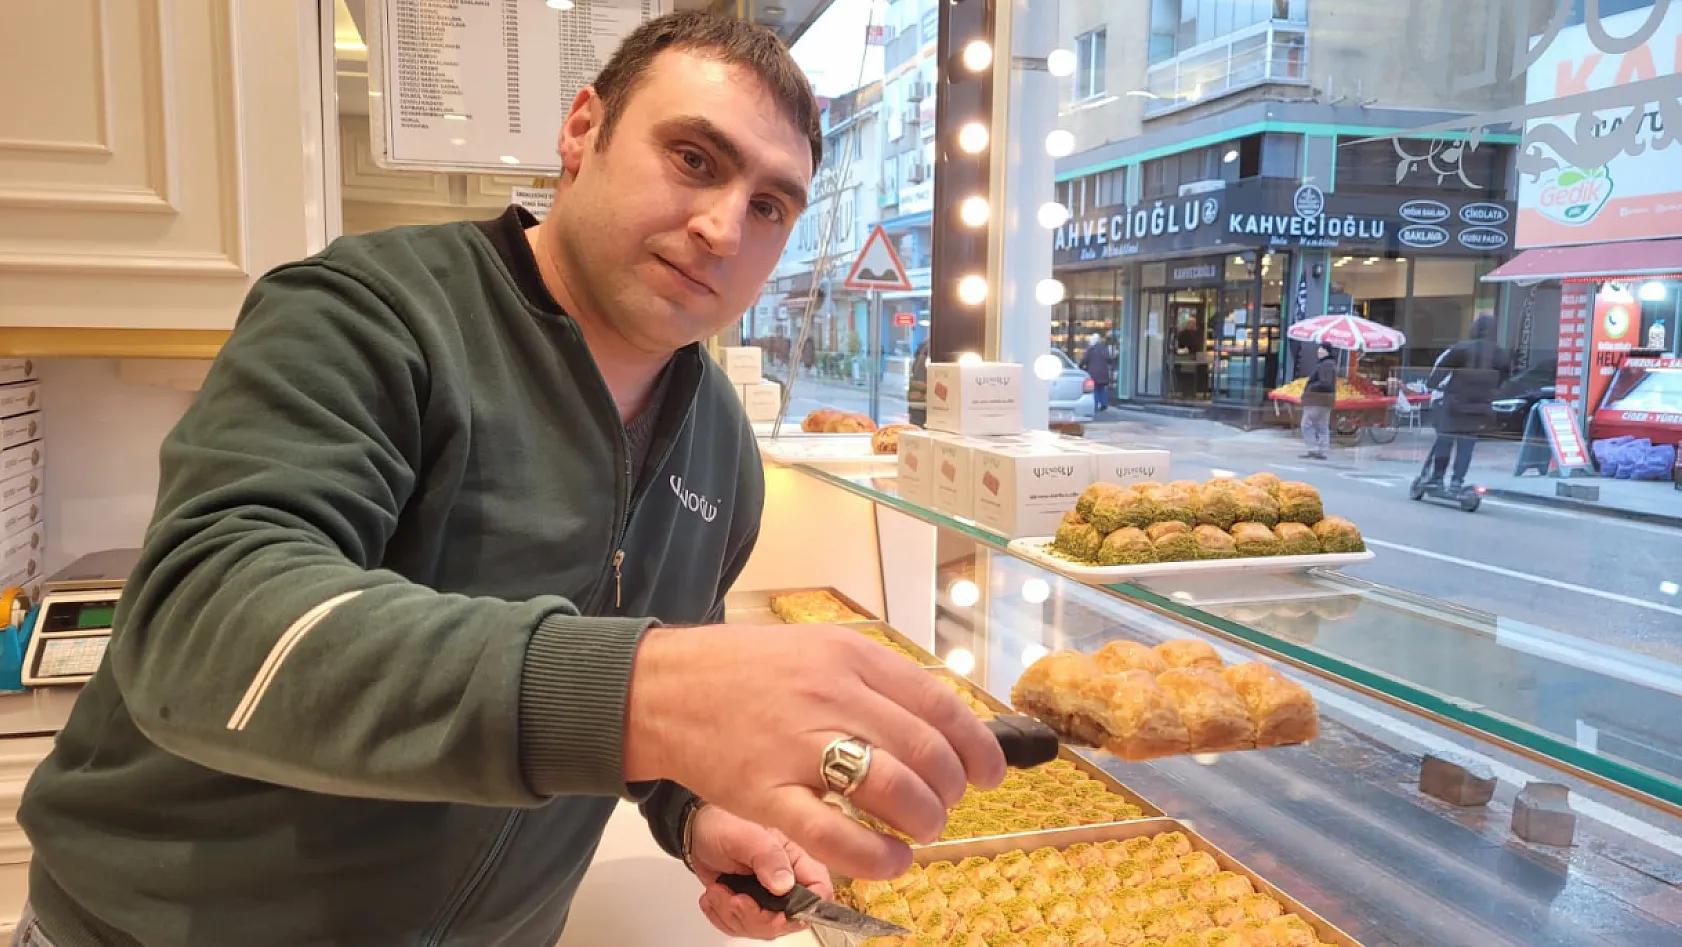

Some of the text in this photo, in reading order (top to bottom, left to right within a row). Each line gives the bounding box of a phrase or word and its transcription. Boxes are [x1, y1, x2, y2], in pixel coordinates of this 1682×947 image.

[1540, 180, 1602, 207] Gedik
[1055, 199, 1200, 250] AHVECİOĞLU
[1229, 213, 1385, 239] KAHVECİOĞLU
[1464, 208, 1502, 220] ÇİKOLATA
[1403, 230, 1443, 241] BAKLAVA
